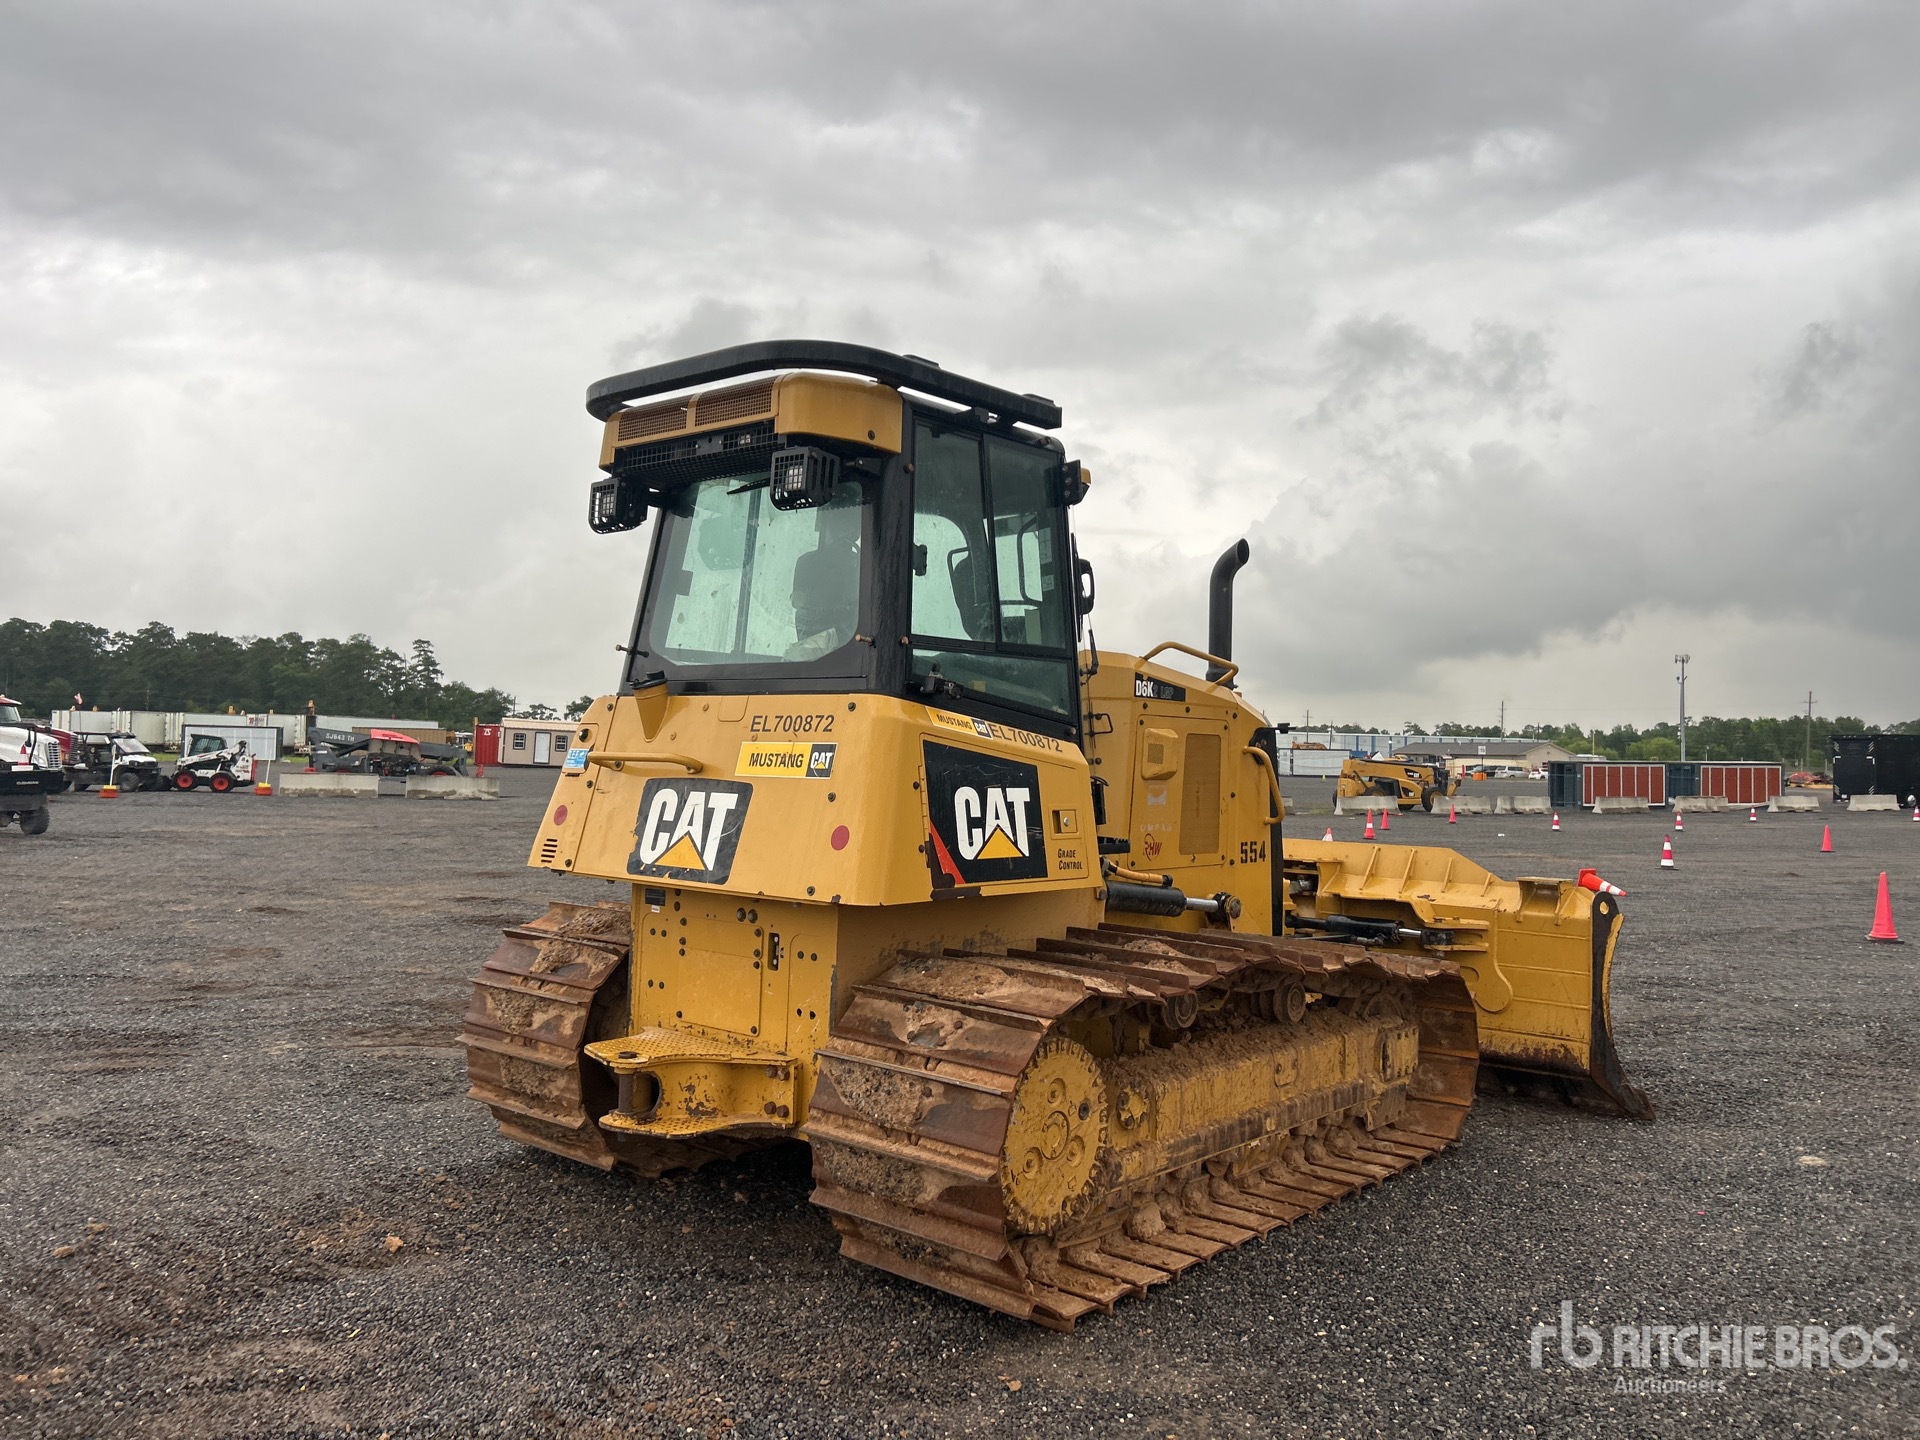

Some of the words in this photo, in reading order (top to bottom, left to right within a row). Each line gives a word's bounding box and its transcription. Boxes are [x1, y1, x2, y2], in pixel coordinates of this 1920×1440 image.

[750, 714, 835, 733] EL700872
[936, 714, 973, 730] MUSTANG
[975, 721, 987, 733] CAT
[987, 723, 1063, 753] EL700872
[749, 753, 804, 769] MUSTANG
[810, 752, 834, 769] CAT
[640, 788, 739, 871] CAT
[954, 786, 1031, 861] CAT
[1240, 841, 1266, 864] 554
